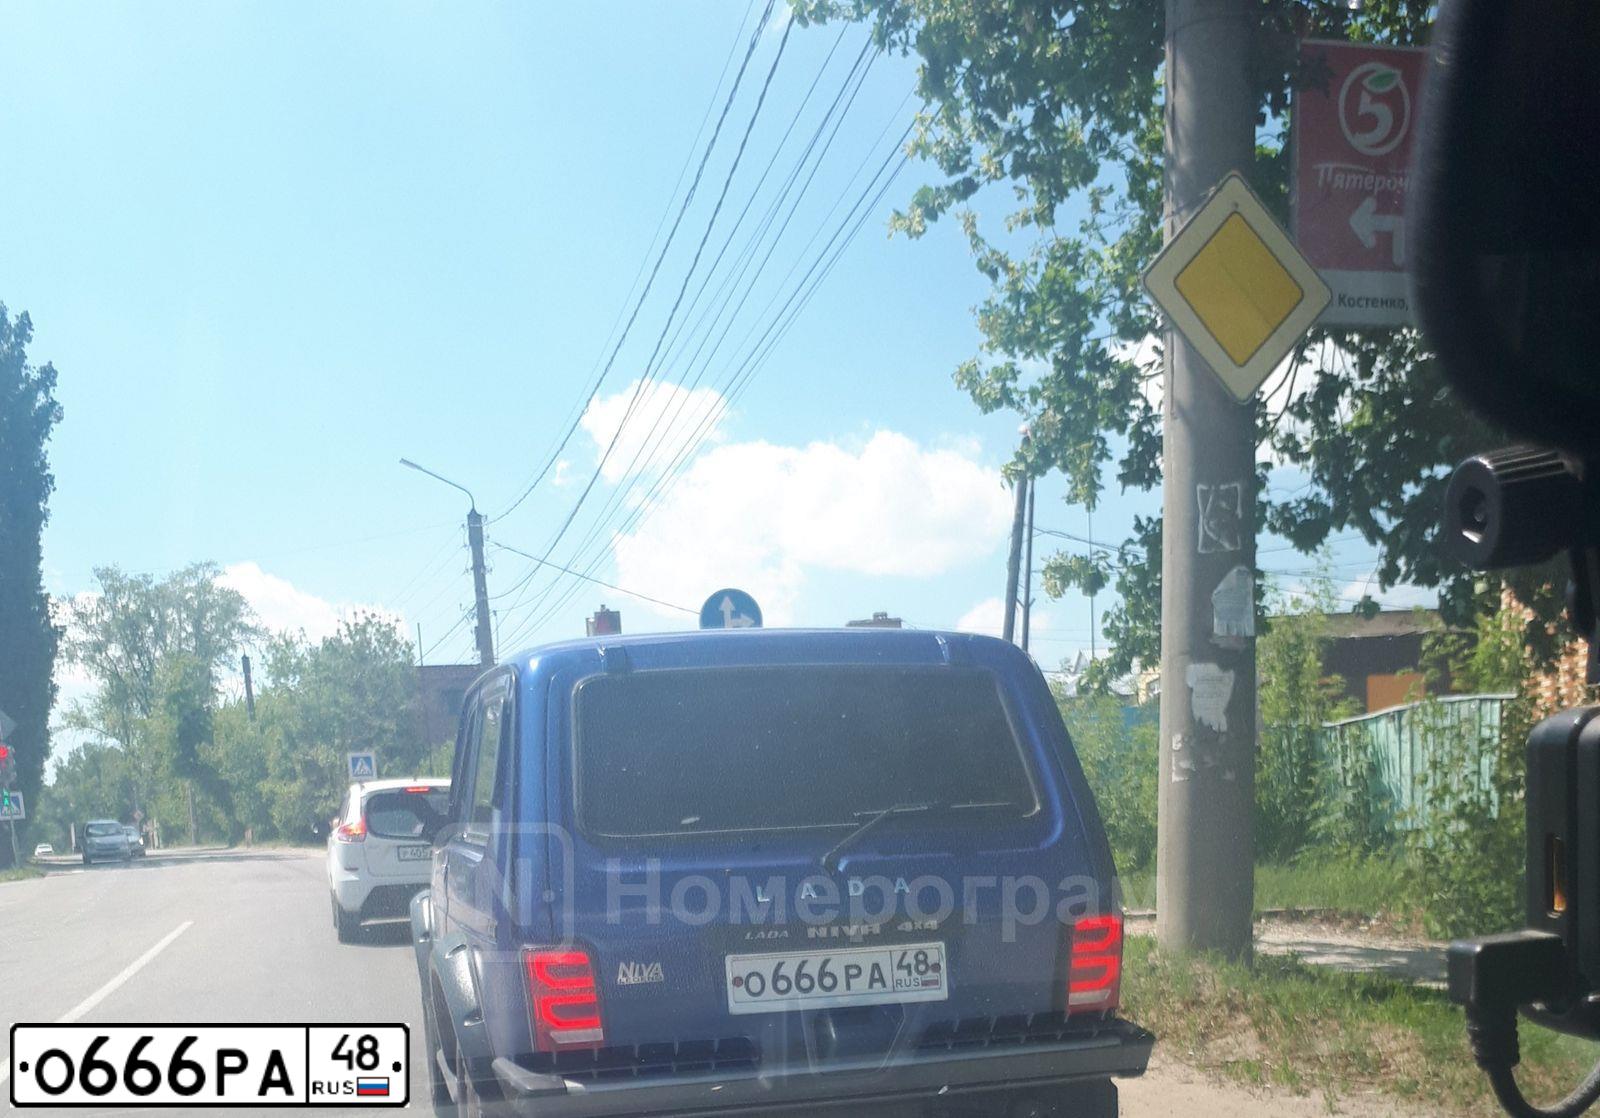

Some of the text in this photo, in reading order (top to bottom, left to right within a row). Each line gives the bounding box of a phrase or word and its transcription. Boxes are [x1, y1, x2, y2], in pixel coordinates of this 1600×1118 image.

[1312, 163, 1414, 195] Пятероч
[896, 951, 930, 977] 48
[895, 976, 920, 989] RUS
